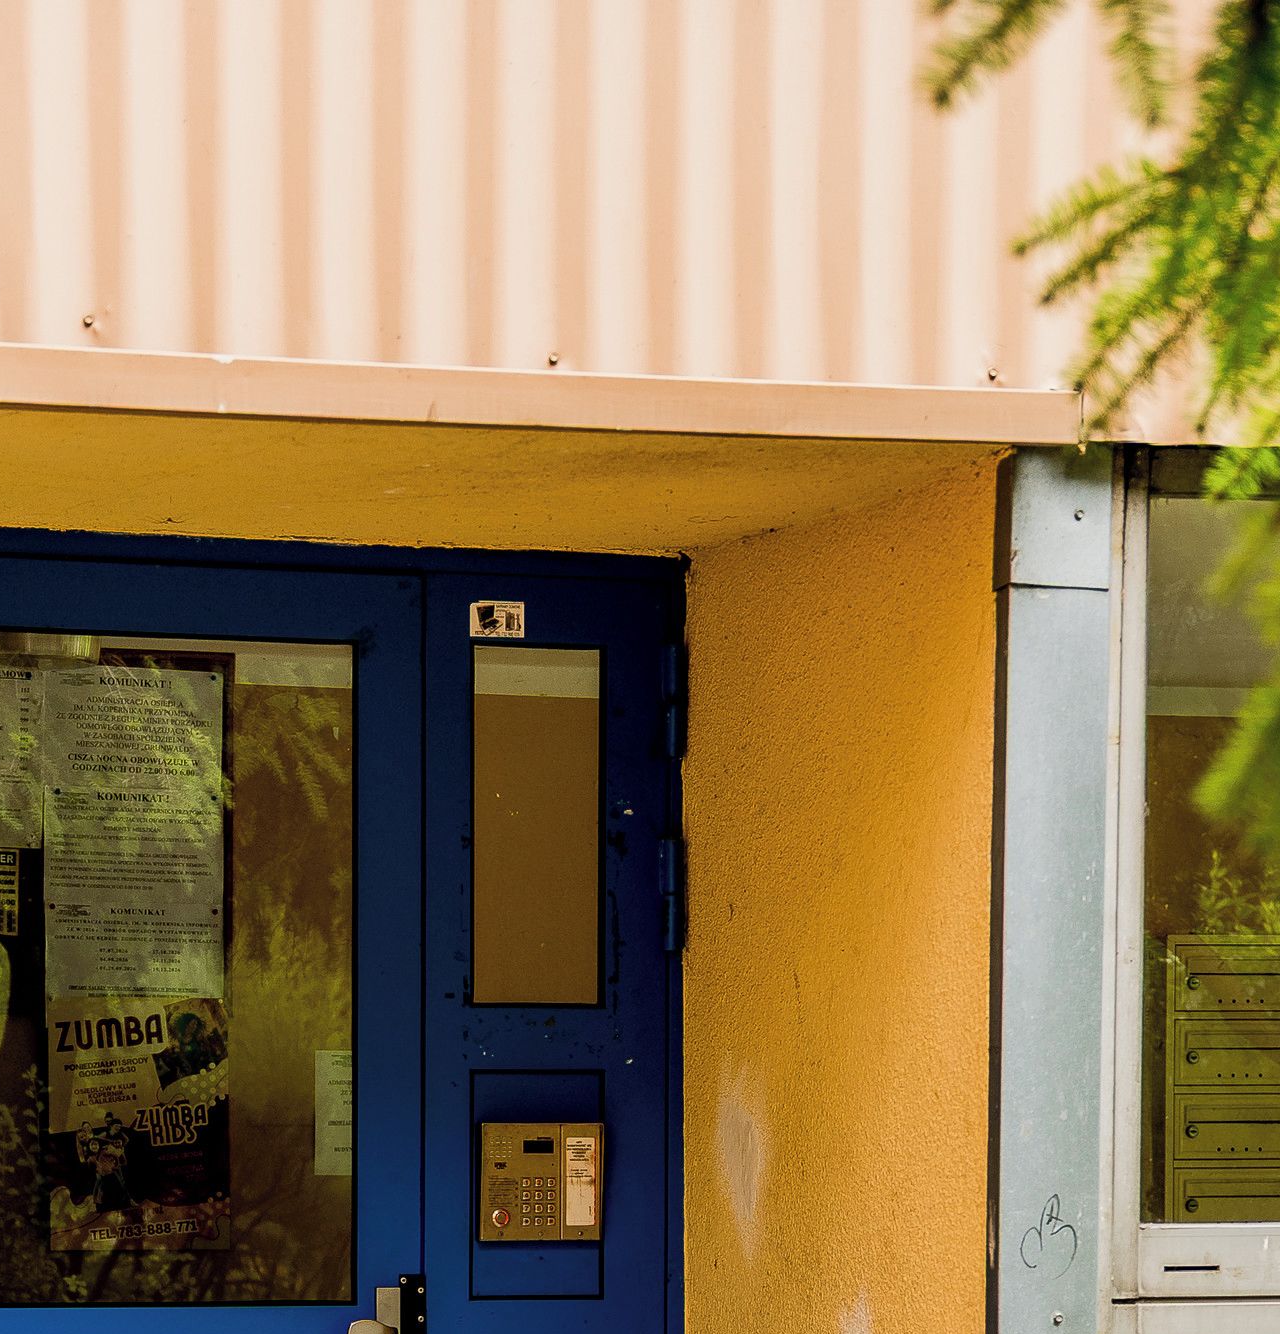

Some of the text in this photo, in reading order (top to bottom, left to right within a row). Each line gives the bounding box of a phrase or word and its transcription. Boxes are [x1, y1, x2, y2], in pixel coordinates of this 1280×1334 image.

[99, 677, 166, 689] KOMUNIKAT
[87, 696, 184, 708] ADMINISTRACJA OSIEDLA
[98, 706, 142, 715] KOPERNIKA
[67, 713, 103, 721] ZGODNIE
[111, 715, 169, 725] REGULAMINEM
[170, 718, 213, 728] PORZĄDKU
[76, 722, 192, 735] DOMOWEGO OBOWIĄZUJĄCYM
[92, 732, 135, 741] ZASOBACH
[76, 740, 139, 750] MIESZKANIOWEJ
[68, 753, 200, 767] CISZA NOCNA OBOWIĄZUJE W
[72, 763, 126, 773] GODZINACH
[128, 766, 142, 774] OD
[97, 792, 164, 803] KOMUNIKAT
[110, 908, 166, 916] KOMUNIKAT
[55, 1013, 163, 1053] ZUMBA
[64, 1059, 117, 1072] PONIEDZIAŁKI
[78, 1067, 114, 1078] GODZINA
[74, 1082, 137, 1095] OSIEDLOWY KLUB
[87, 1090, 124, 1100] KOPERNIK
[135, 1103, 209, 1131] ZUMBA
[150, 1124, 199, 1147] KIDS
[90, 1219, 197, 1240] TEL. 783-888-771
